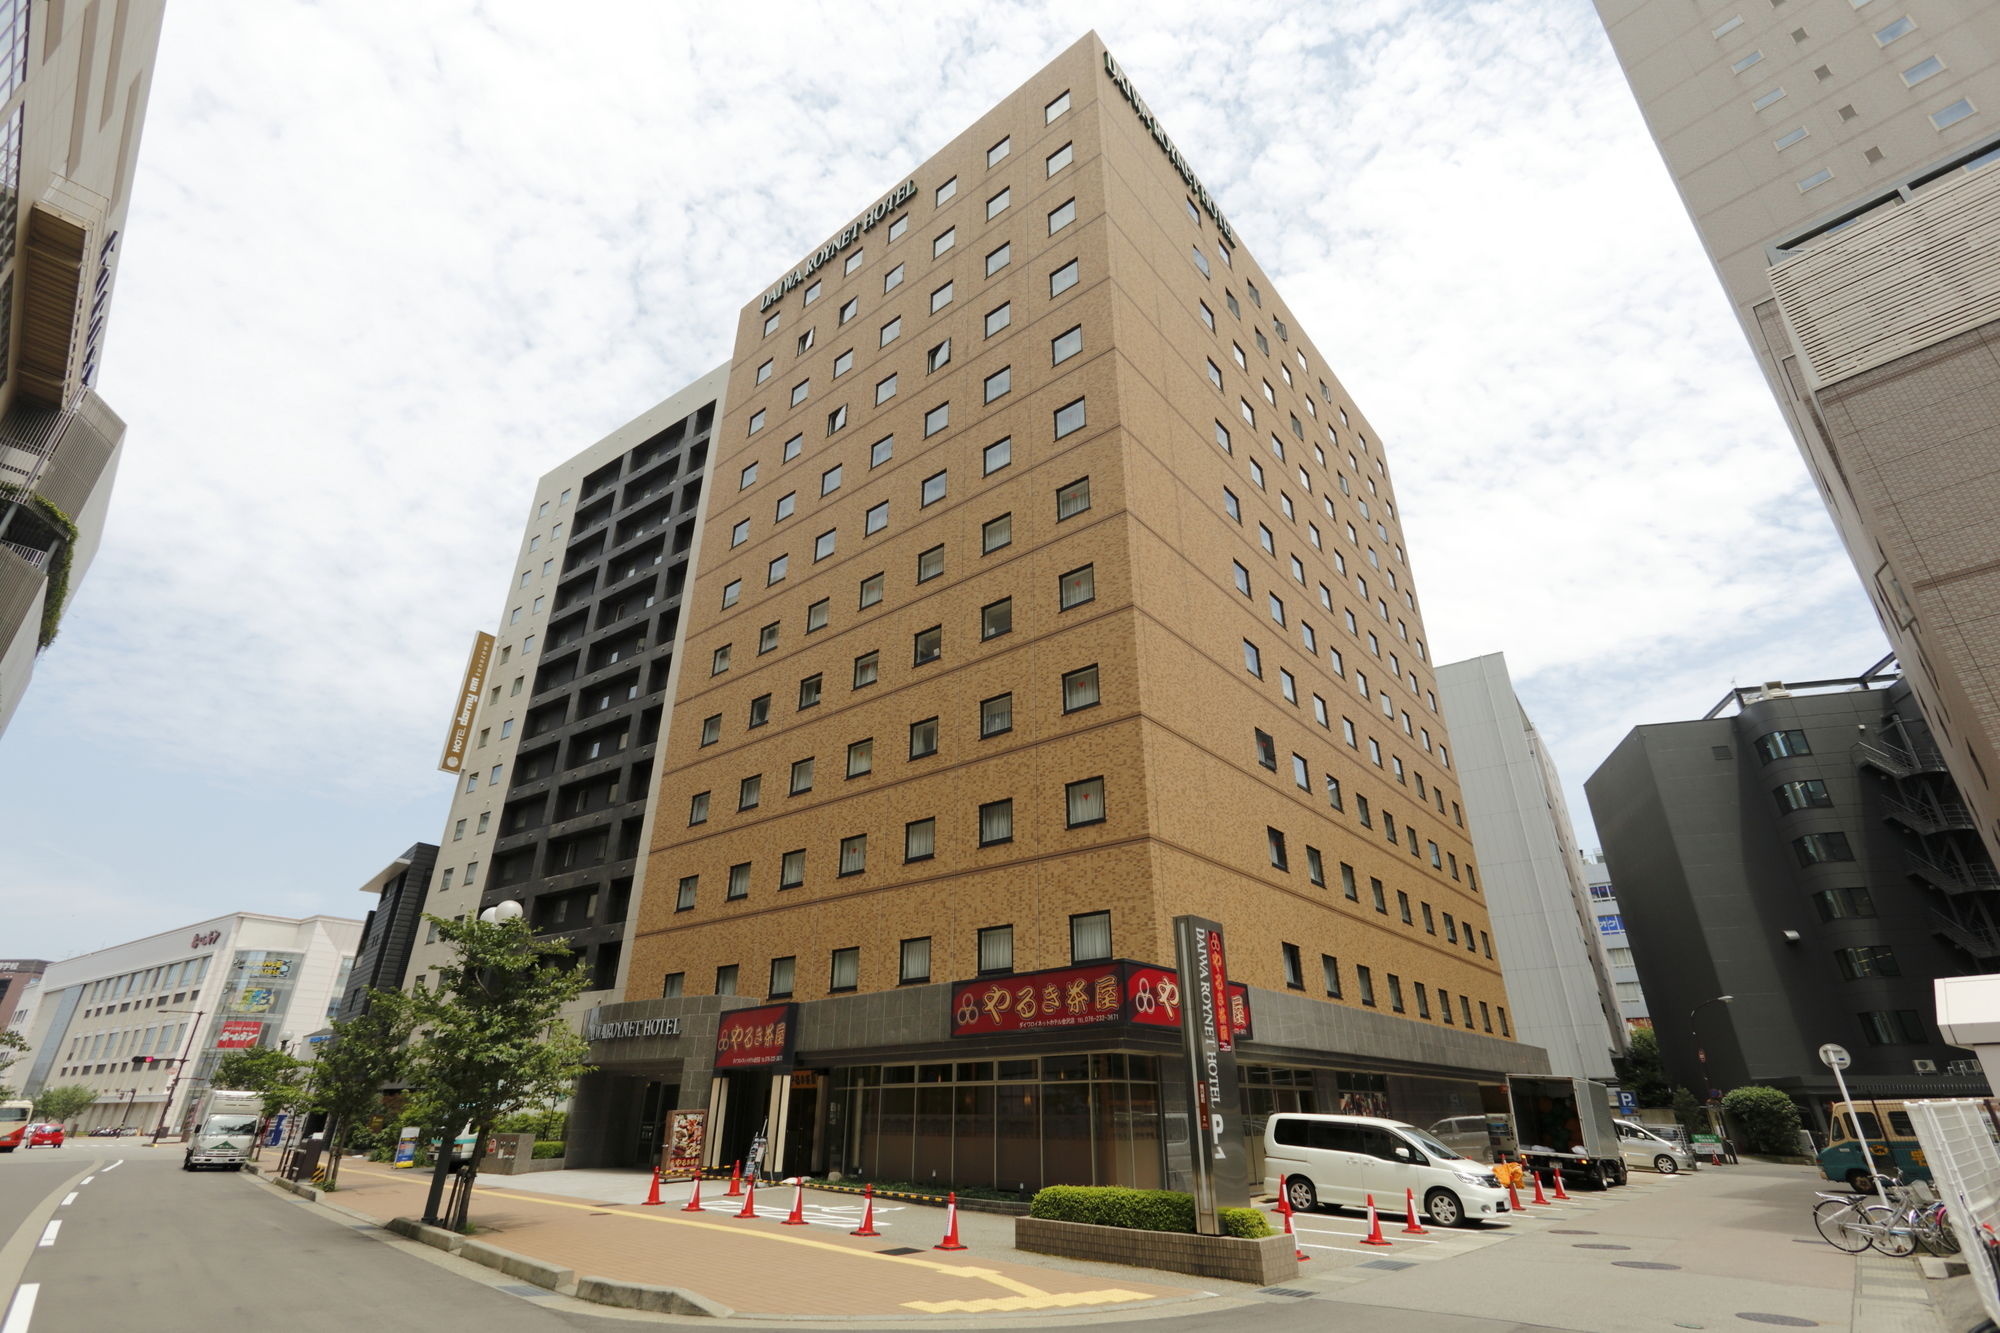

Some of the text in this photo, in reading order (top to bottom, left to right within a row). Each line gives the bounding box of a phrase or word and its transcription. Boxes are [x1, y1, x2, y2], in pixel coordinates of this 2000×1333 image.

[760, 180, 918, 312] DAIWA ROYNET HOTEL
[469, 677, 480, 692] inn
[457, 694, 479, 727] dormy
[452, 728, 466, 753] HOTEL
[982, 974, 1120, 1025] やるき茶屋
[643, 1018, 680, 1036] HOTEL
[1196, 928, 1220, 1109] DAIWA ROYNET HOTEL
[1620, 1092, 1632, 1106] P
[1211, 1113, 1224, 1144] P
